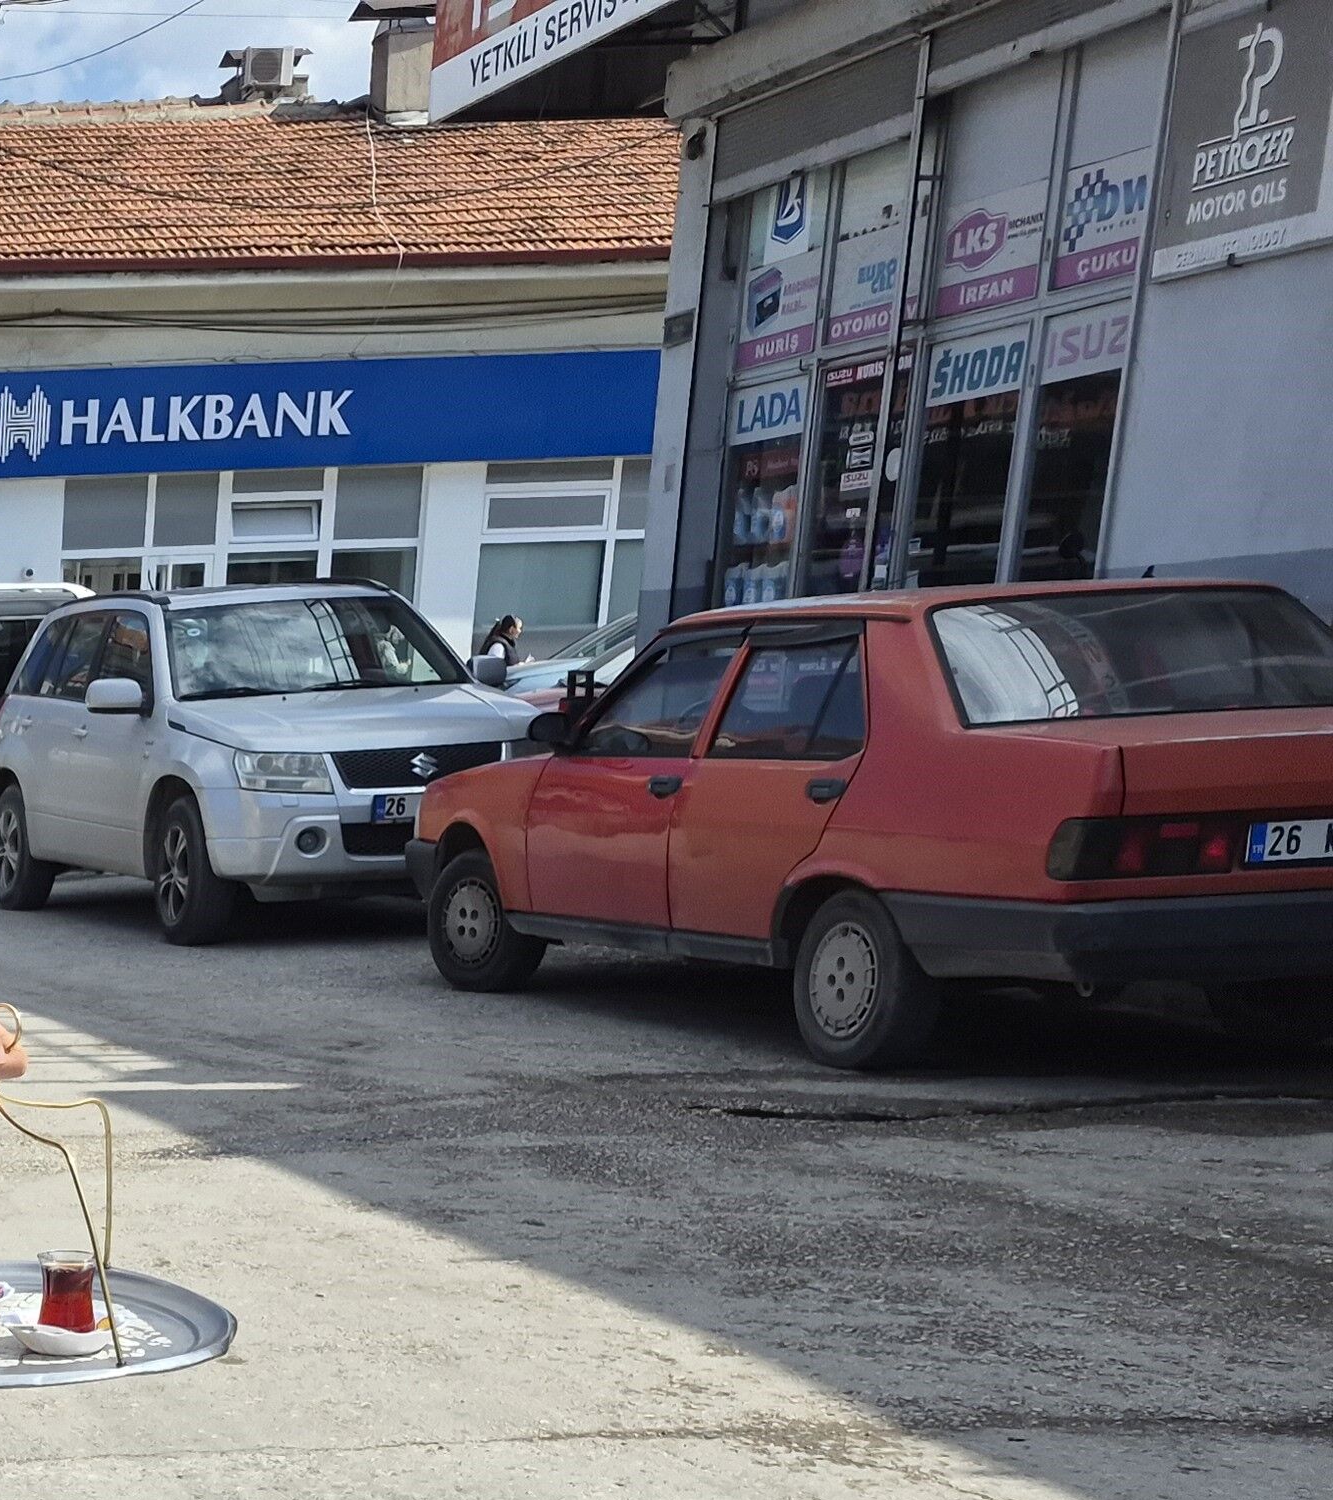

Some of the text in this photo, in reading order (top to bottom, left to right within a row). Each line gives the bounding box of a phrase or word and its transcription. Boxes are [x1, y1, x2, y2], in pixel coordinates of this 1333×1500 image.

[470, 17, 539, 87] YETKİLİ
[1192, 127, 1295, 185] PETROFER
[1186, 178, 1287, 225] MOTOR OILS
[952, 223, 999, 259] LKS
[755, 333, 799, 360] NURİŞ
[959, 277, 1014, 306] İRFAN
[60, 389, 355, 445] HALKBANK
[737, 388, 802, 434] LADA
[385, 796, 406, 816] 26
[1268, 825, 1302, 856] 26
